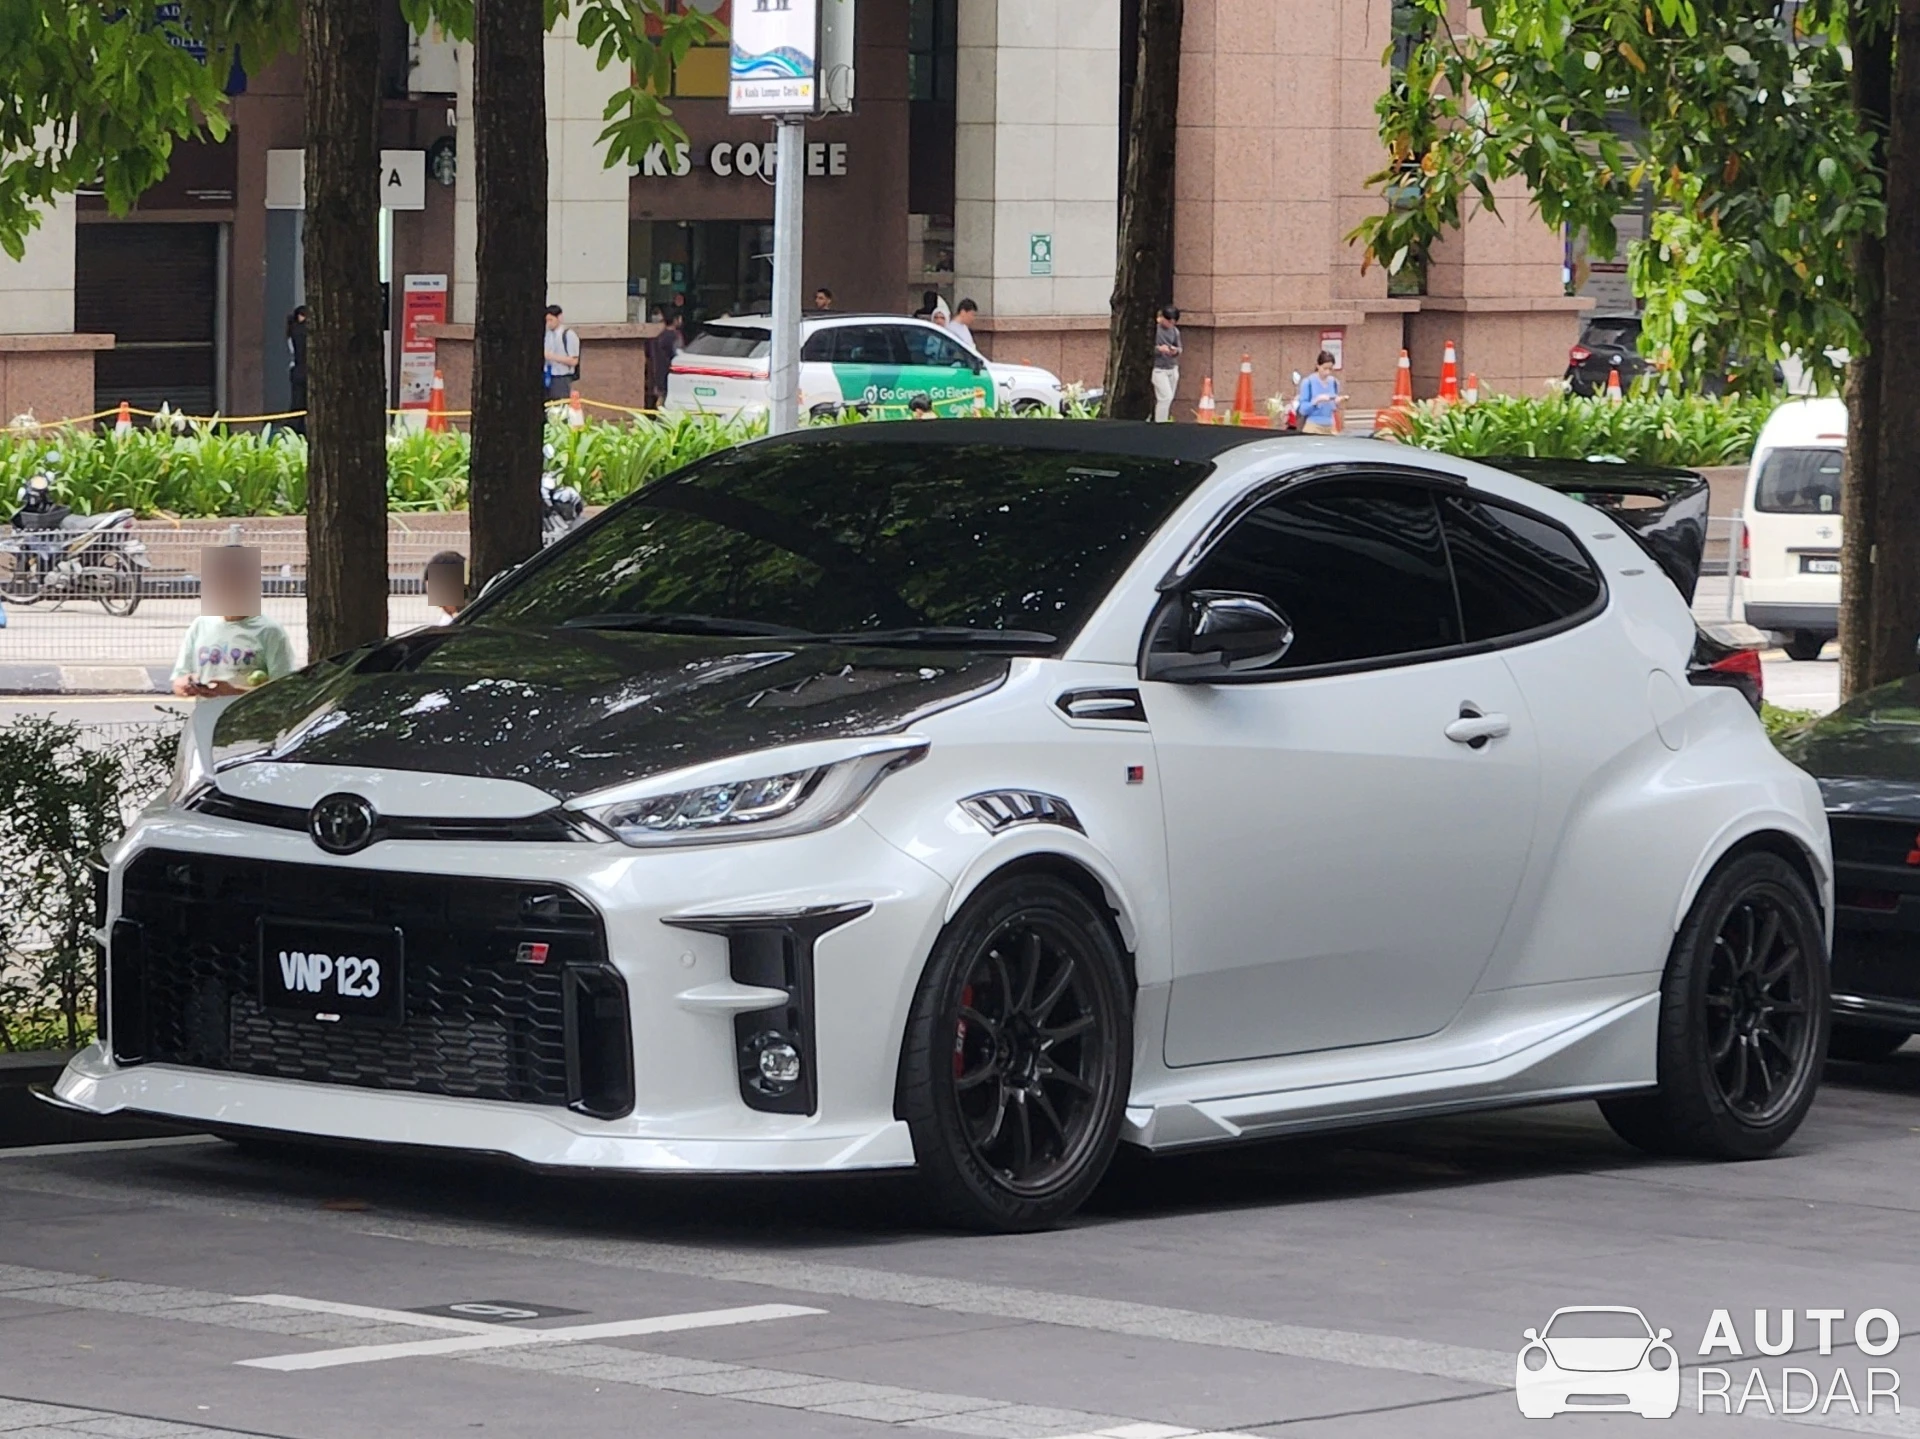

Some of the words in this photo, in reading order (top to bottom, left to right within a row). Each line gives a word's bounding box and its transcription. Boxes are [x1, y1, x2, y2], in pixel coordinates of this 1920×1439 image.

[710, 142, 848, 177] COFEE
[879, 387, 895, 400] Go
[930, 386, 946, 399] Go
